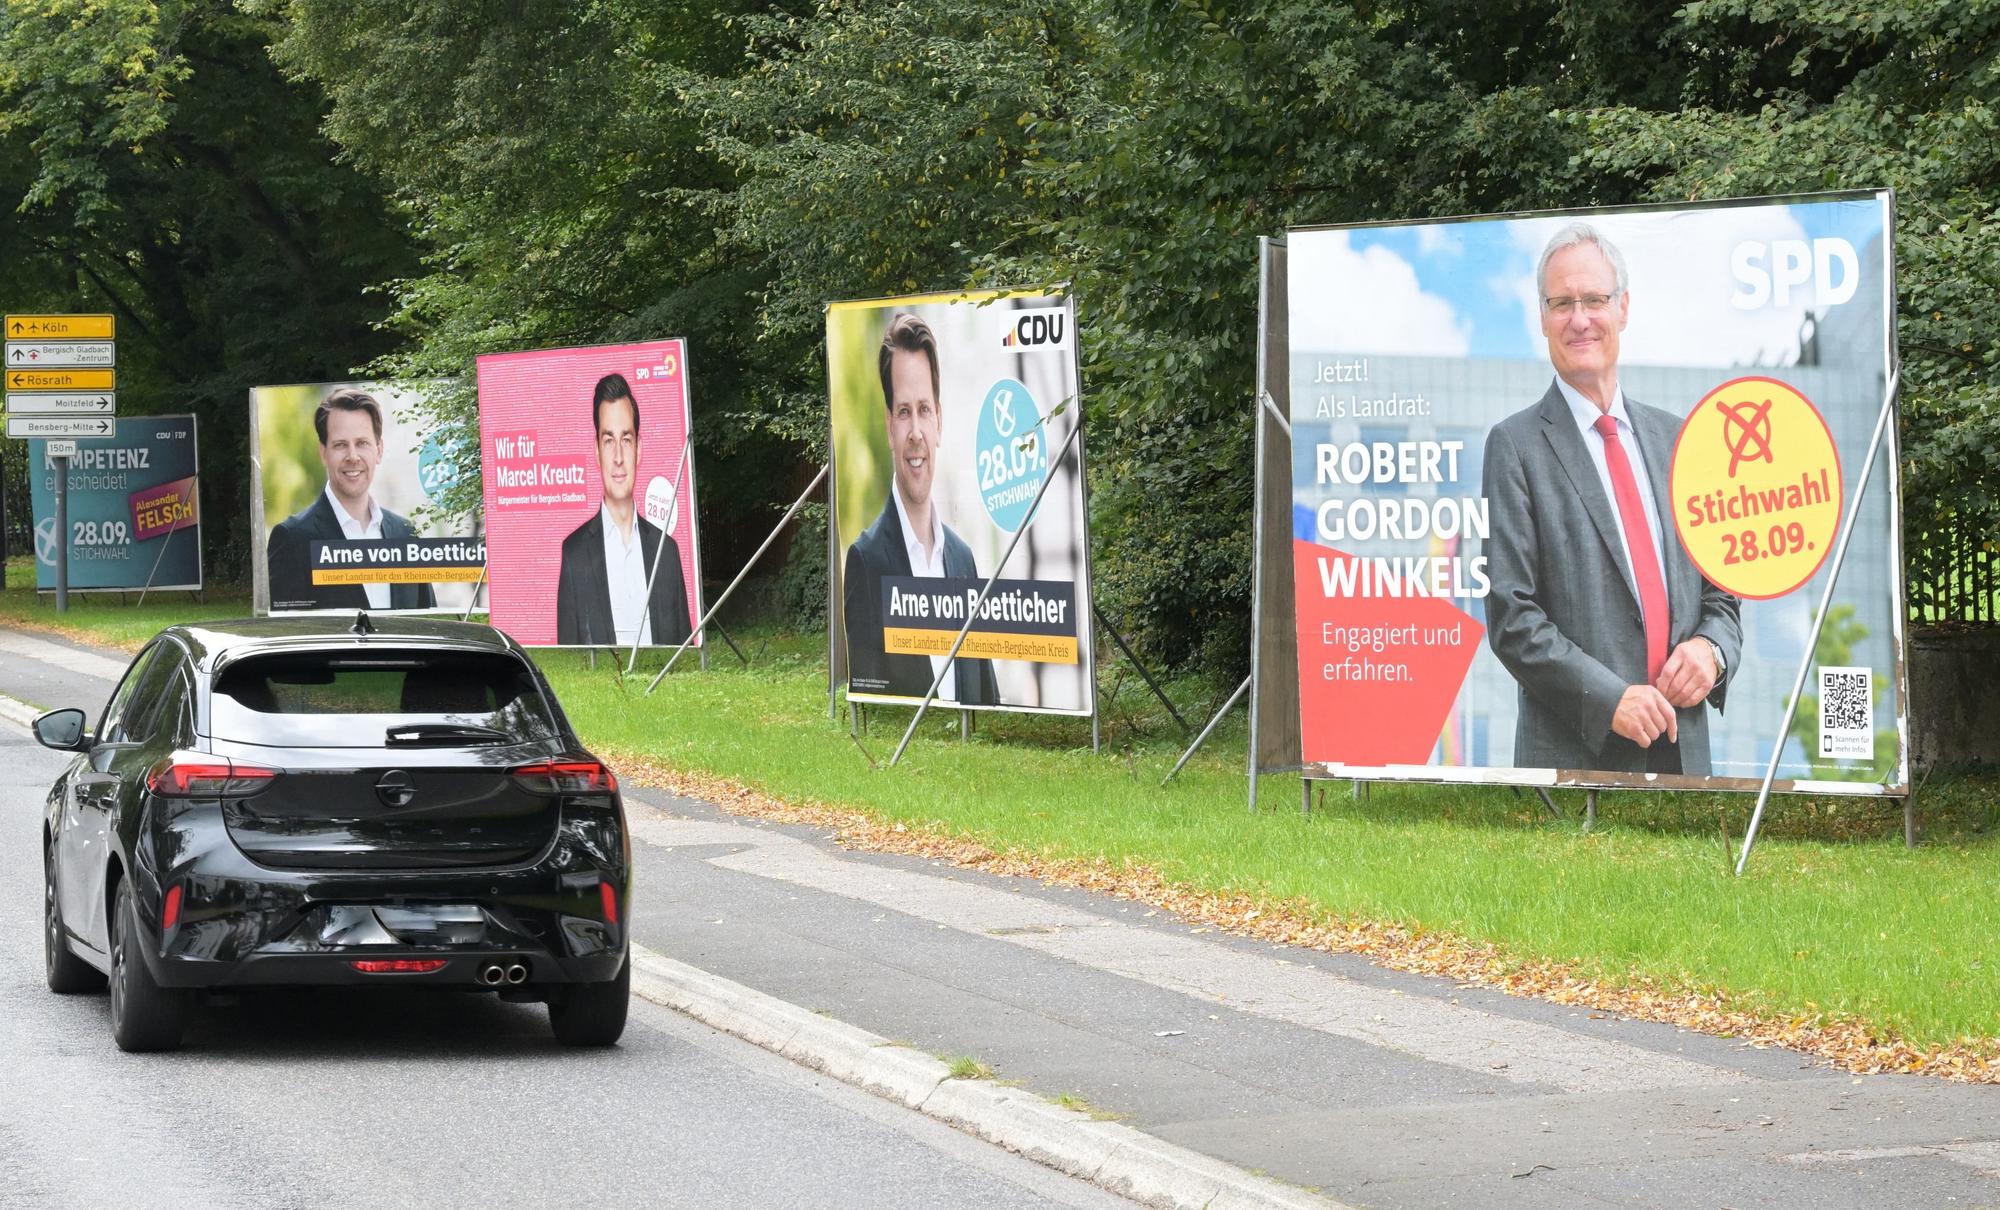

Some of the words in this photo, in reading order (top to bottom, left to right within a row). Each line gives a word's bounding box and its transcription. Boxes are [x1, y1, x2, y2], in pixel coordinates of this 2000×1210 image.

[1730, 237, 1859, 310] SPD
[42, 322, 68, 332] Köln
[1017, 313, 1064, 346] CDU
[42, 346, 75, 355] Bergisch
[27, 375, 72, 385] Rösrath
[636, 367, 650, 380] SPD
[1314, 359, 1369, 383] Jetzt!
[1316, 396, 1346, 418] Als
[1351, 393, 1431, 417] Landrat:
[28, 423, 94, 432] Bensberg-Mitte
[174, 431, 187, 439] FDP
[45, 447, 150, 470] KMPETENZ
[495, 436, 515, 459] Wir
[517, 435, 536, 458] für
[979, 434, 1046, 492] 28.09.
[1316, 440, 1463, 484] ROBERT
[45, 471, 127, 491] escheidet!
[497, 463, 538, 488] Marcel
[541, 463, 585, 486] Kreutz
[136, 493, 179, 512] Alexander
[1687, 469, 1831, 528] Stichwahl
[137, 501, 193, 532] FELSCH
[1317, 497, 1491, 541] GORDON
[73, 521, 131, 545] 28.09.
[1721, 522, 1815, 565] 28.09.
[73, 547, 130, 561] STICHWAHL
[319, 545, 363, 563] Arne
[367, 547, 402, 562] von
[406, 542, 487, 562] Boettich
[322, 573, 344, 582] Unser
[345, 572, 374, 581] Landrat
[375, 571, 388, 581] für
[1317, 555, 1491, 598] WINKELS
[890, 586, 930, 618] Arne
[932, 595, 964, 619] von
[967, 588, 1067, 624] Boetticher
[893, 634, 912, 648] Unser
[913, 635, 940, 650] Landrat
[940, 637, 952, 651] für
[966, 638, 1046, 658] Rheinisch-Bergischen
[1048, 642, 1069, 657] Kreis
[1323, 622, 1418, 652] Engagiert
[1424, 622, 1461, 645] und
[1323, 657, 1413, 681] erfahren.
[1835, 735, 1860, 743] Scannen
[1861, 735, 1870, 744] für
[1835, 745, 1850, 753] mehr
